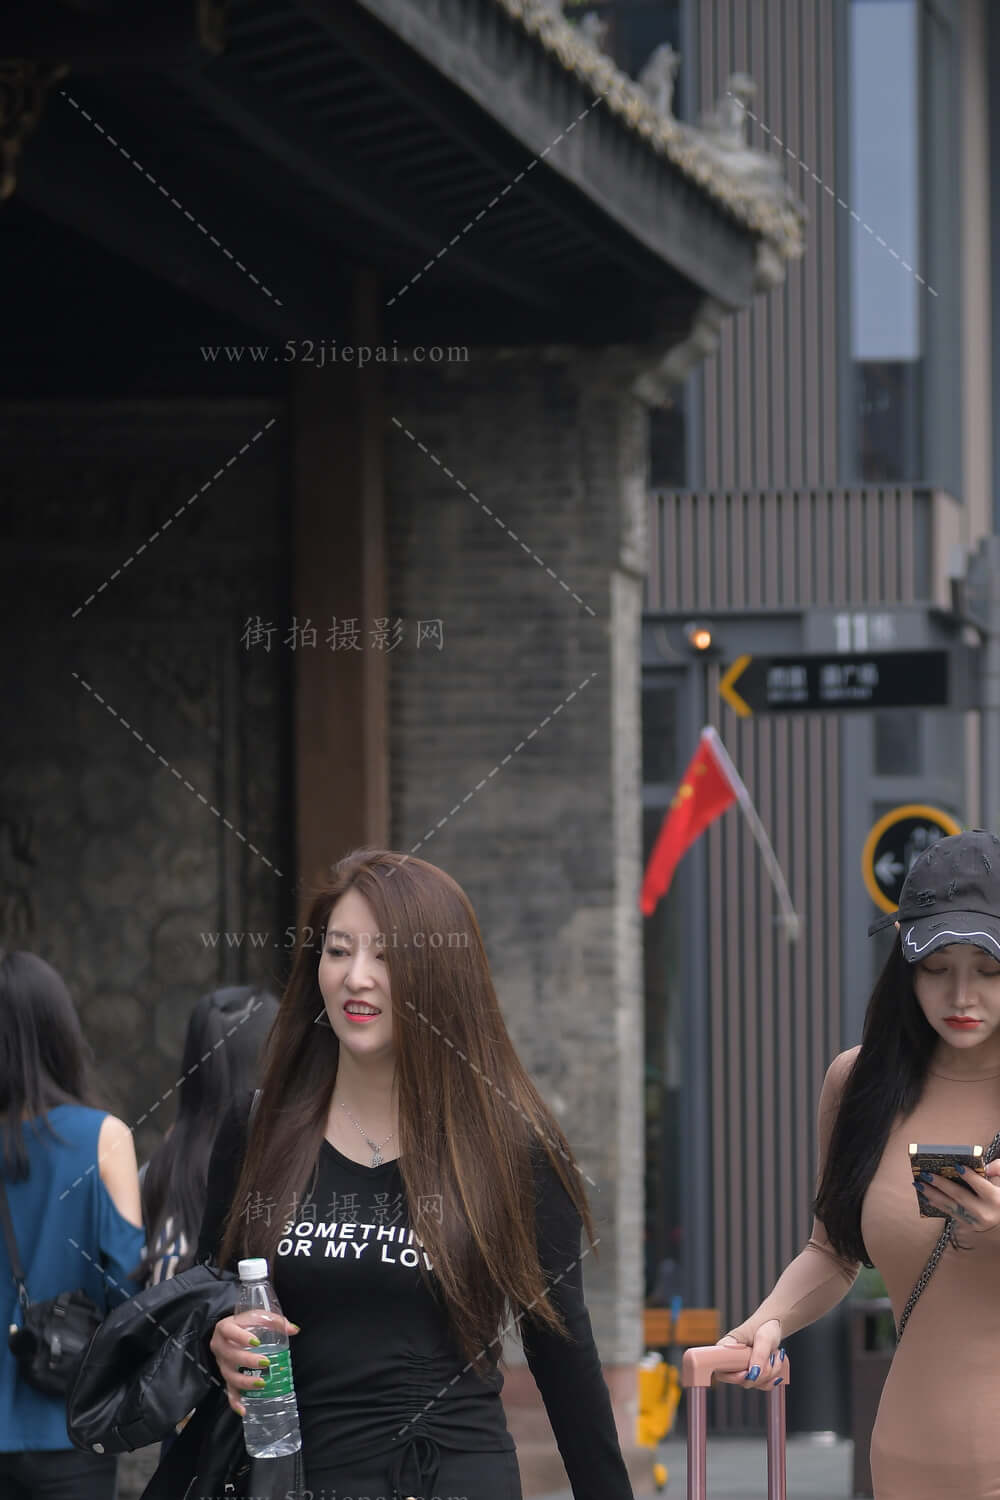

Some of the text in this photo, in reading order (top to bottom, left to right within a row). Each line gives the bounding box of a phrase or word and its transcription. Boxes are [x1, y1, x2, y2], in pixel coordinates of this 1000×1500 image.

[281, 1220, 424, 1248] SOMETHIN
[324, 1241, 369, 1260] MY
[381, 1244, 433, 1271] LOV
